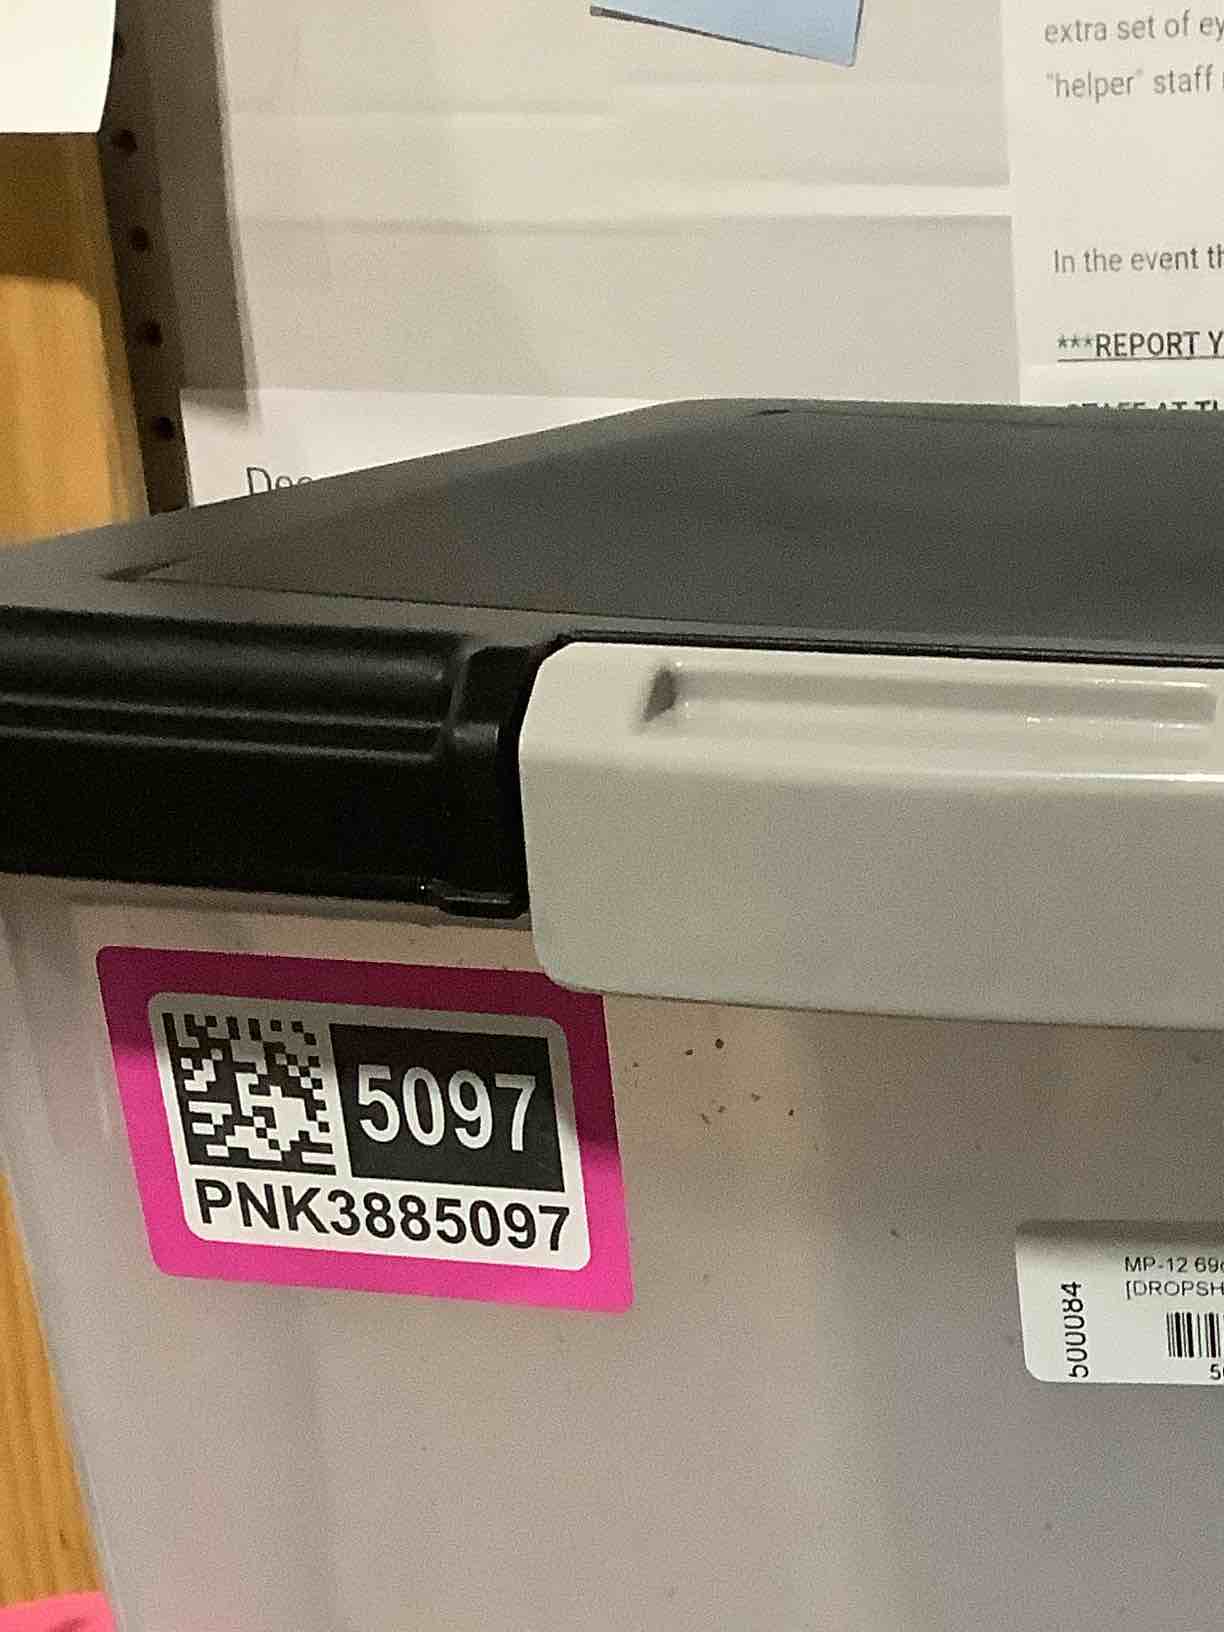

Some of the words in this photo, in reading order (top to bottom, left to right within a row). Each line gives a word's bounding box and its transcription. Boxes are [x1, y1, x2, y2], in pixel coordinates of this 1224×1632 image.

[1044, 19, 1107, 43] extra
[1117, 16, 1155, 40] set
[1164, 9, 1191, 38] of
[1153, 64, 1213, 95] staff
[1053, 249, 1075, 273] In
[1084, 248, 1122, 273] the
[1131, 248, 1200, 271] event
[357, 1063, 536, 1152] 5097
[194, 1178, 570, 1252] PNK3885097
[1125, 1256, 1187, 1274] MP-12
